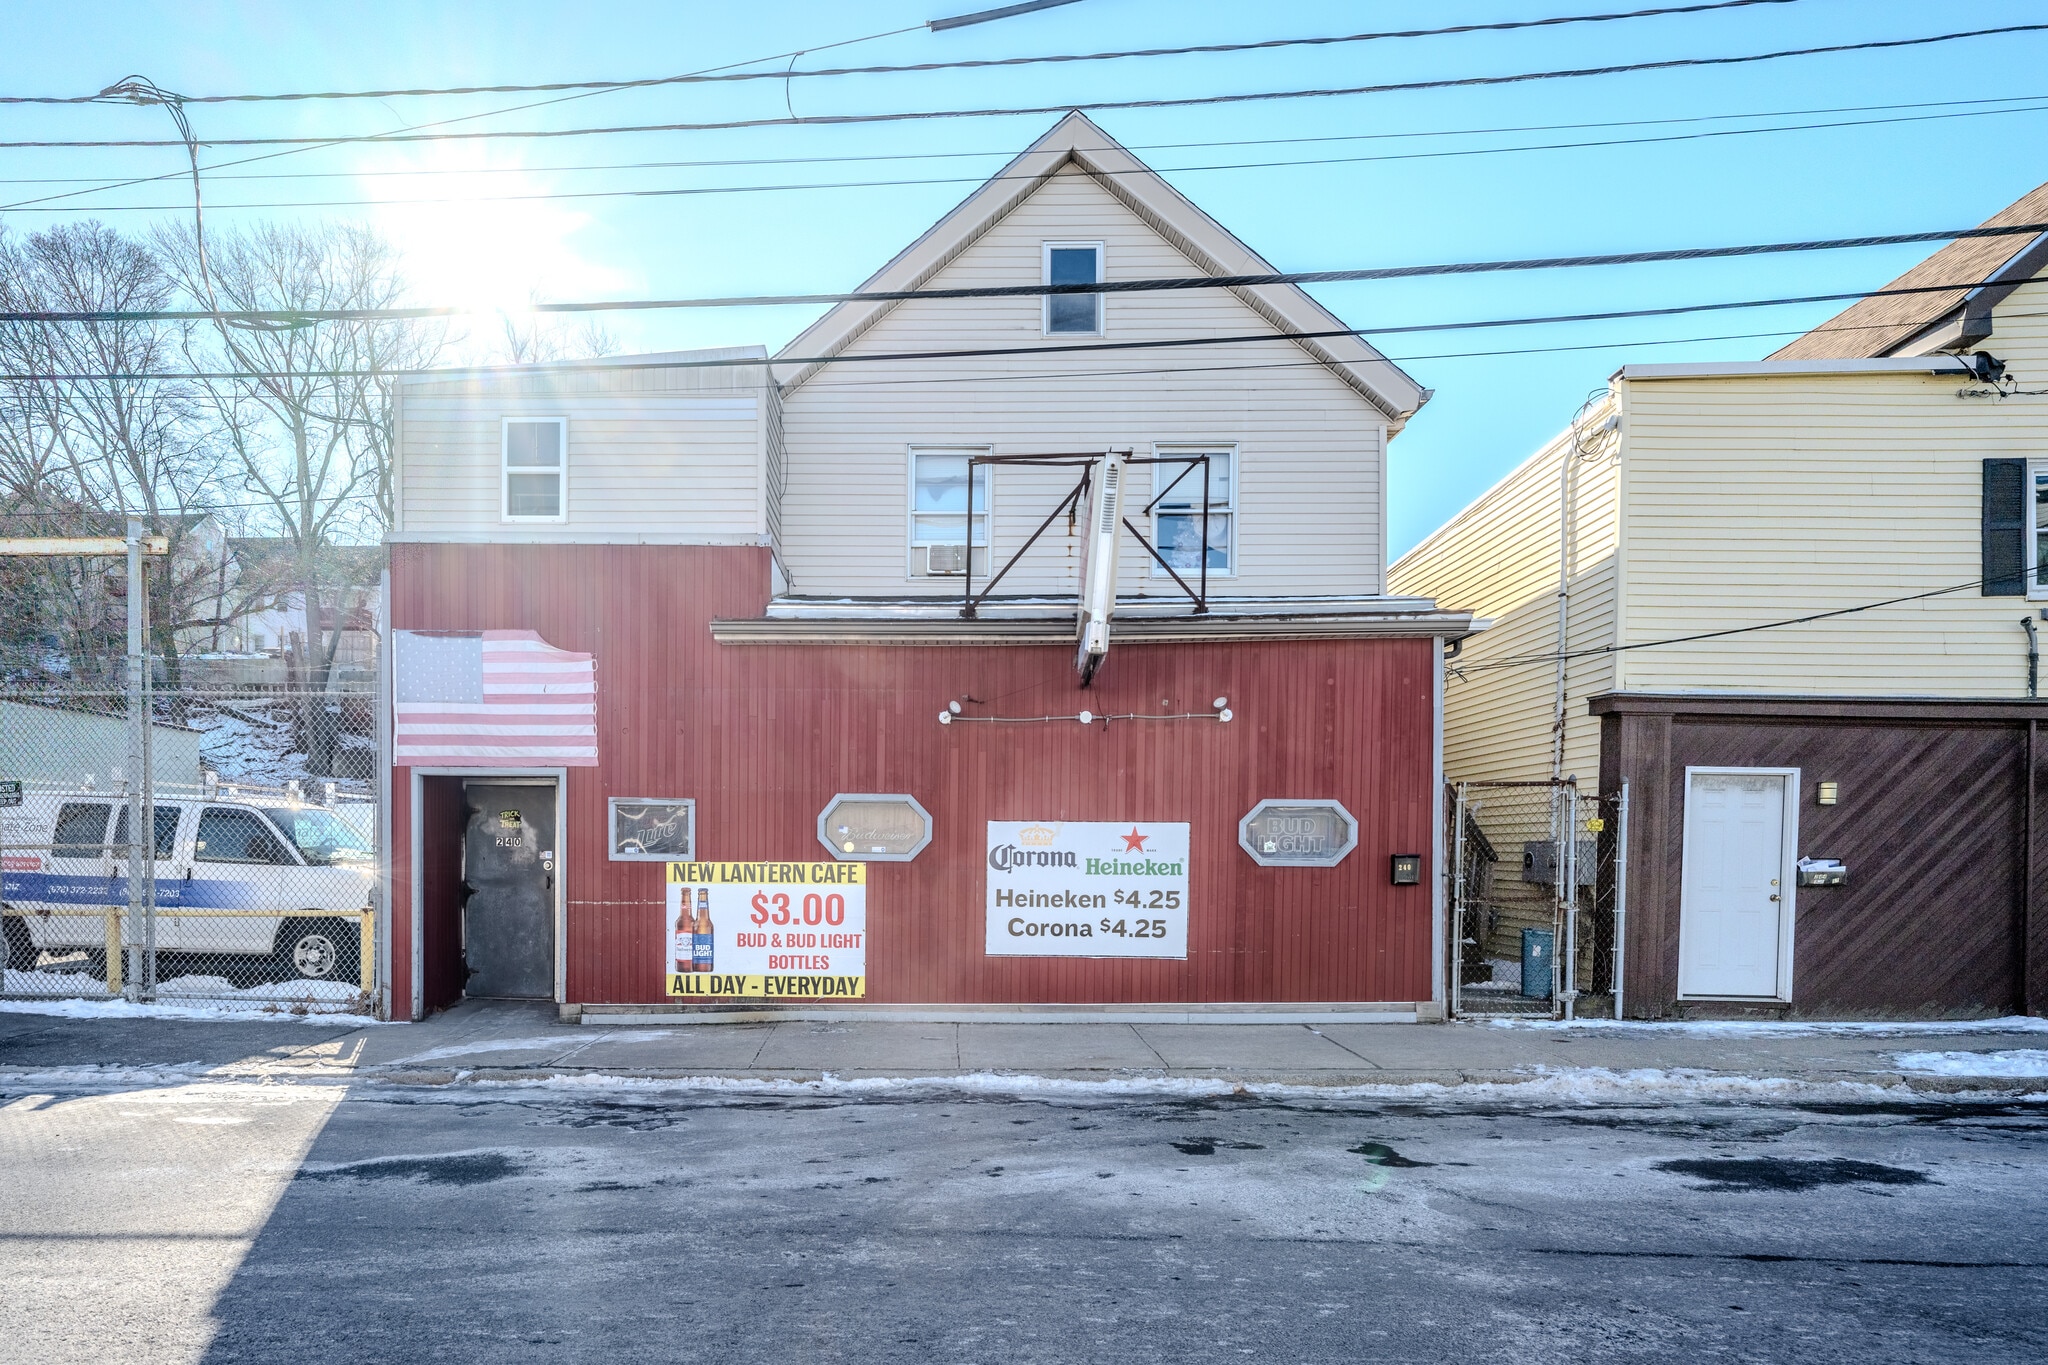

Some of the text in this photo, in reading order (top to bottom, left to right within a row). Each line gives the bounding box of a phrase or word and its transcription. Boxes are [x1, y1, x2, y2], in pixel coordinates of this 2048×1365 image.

[500, 820, 521, 828] TREAT
[1267, 818, 1316, 835] BUD
[496, 838, 521, 847] 240
[841, 827, 912, 841] Budweiser
[989, 843, 1078, 873] Corona
[673, 863, 858, 883] NEW LANTERN CAFE
[1085, 858, 1183, 876] Heineken
[1398, 863, 1412, 871] 240
[995, 888, 1181, 909] Heineken $4.25
[750, 890, 845, 928] $3.00
[1007, 917, 1167, 938] Corona $4.25
[737, 933, 862, 948] BUD & BUD LIGHT
[769, 955, 830, 970] BOTTLES
[673, 975, 704, 994] ALL
[710, 976, 746, 994] DAY
[764, 976, 859, 996] EVERYDAY
